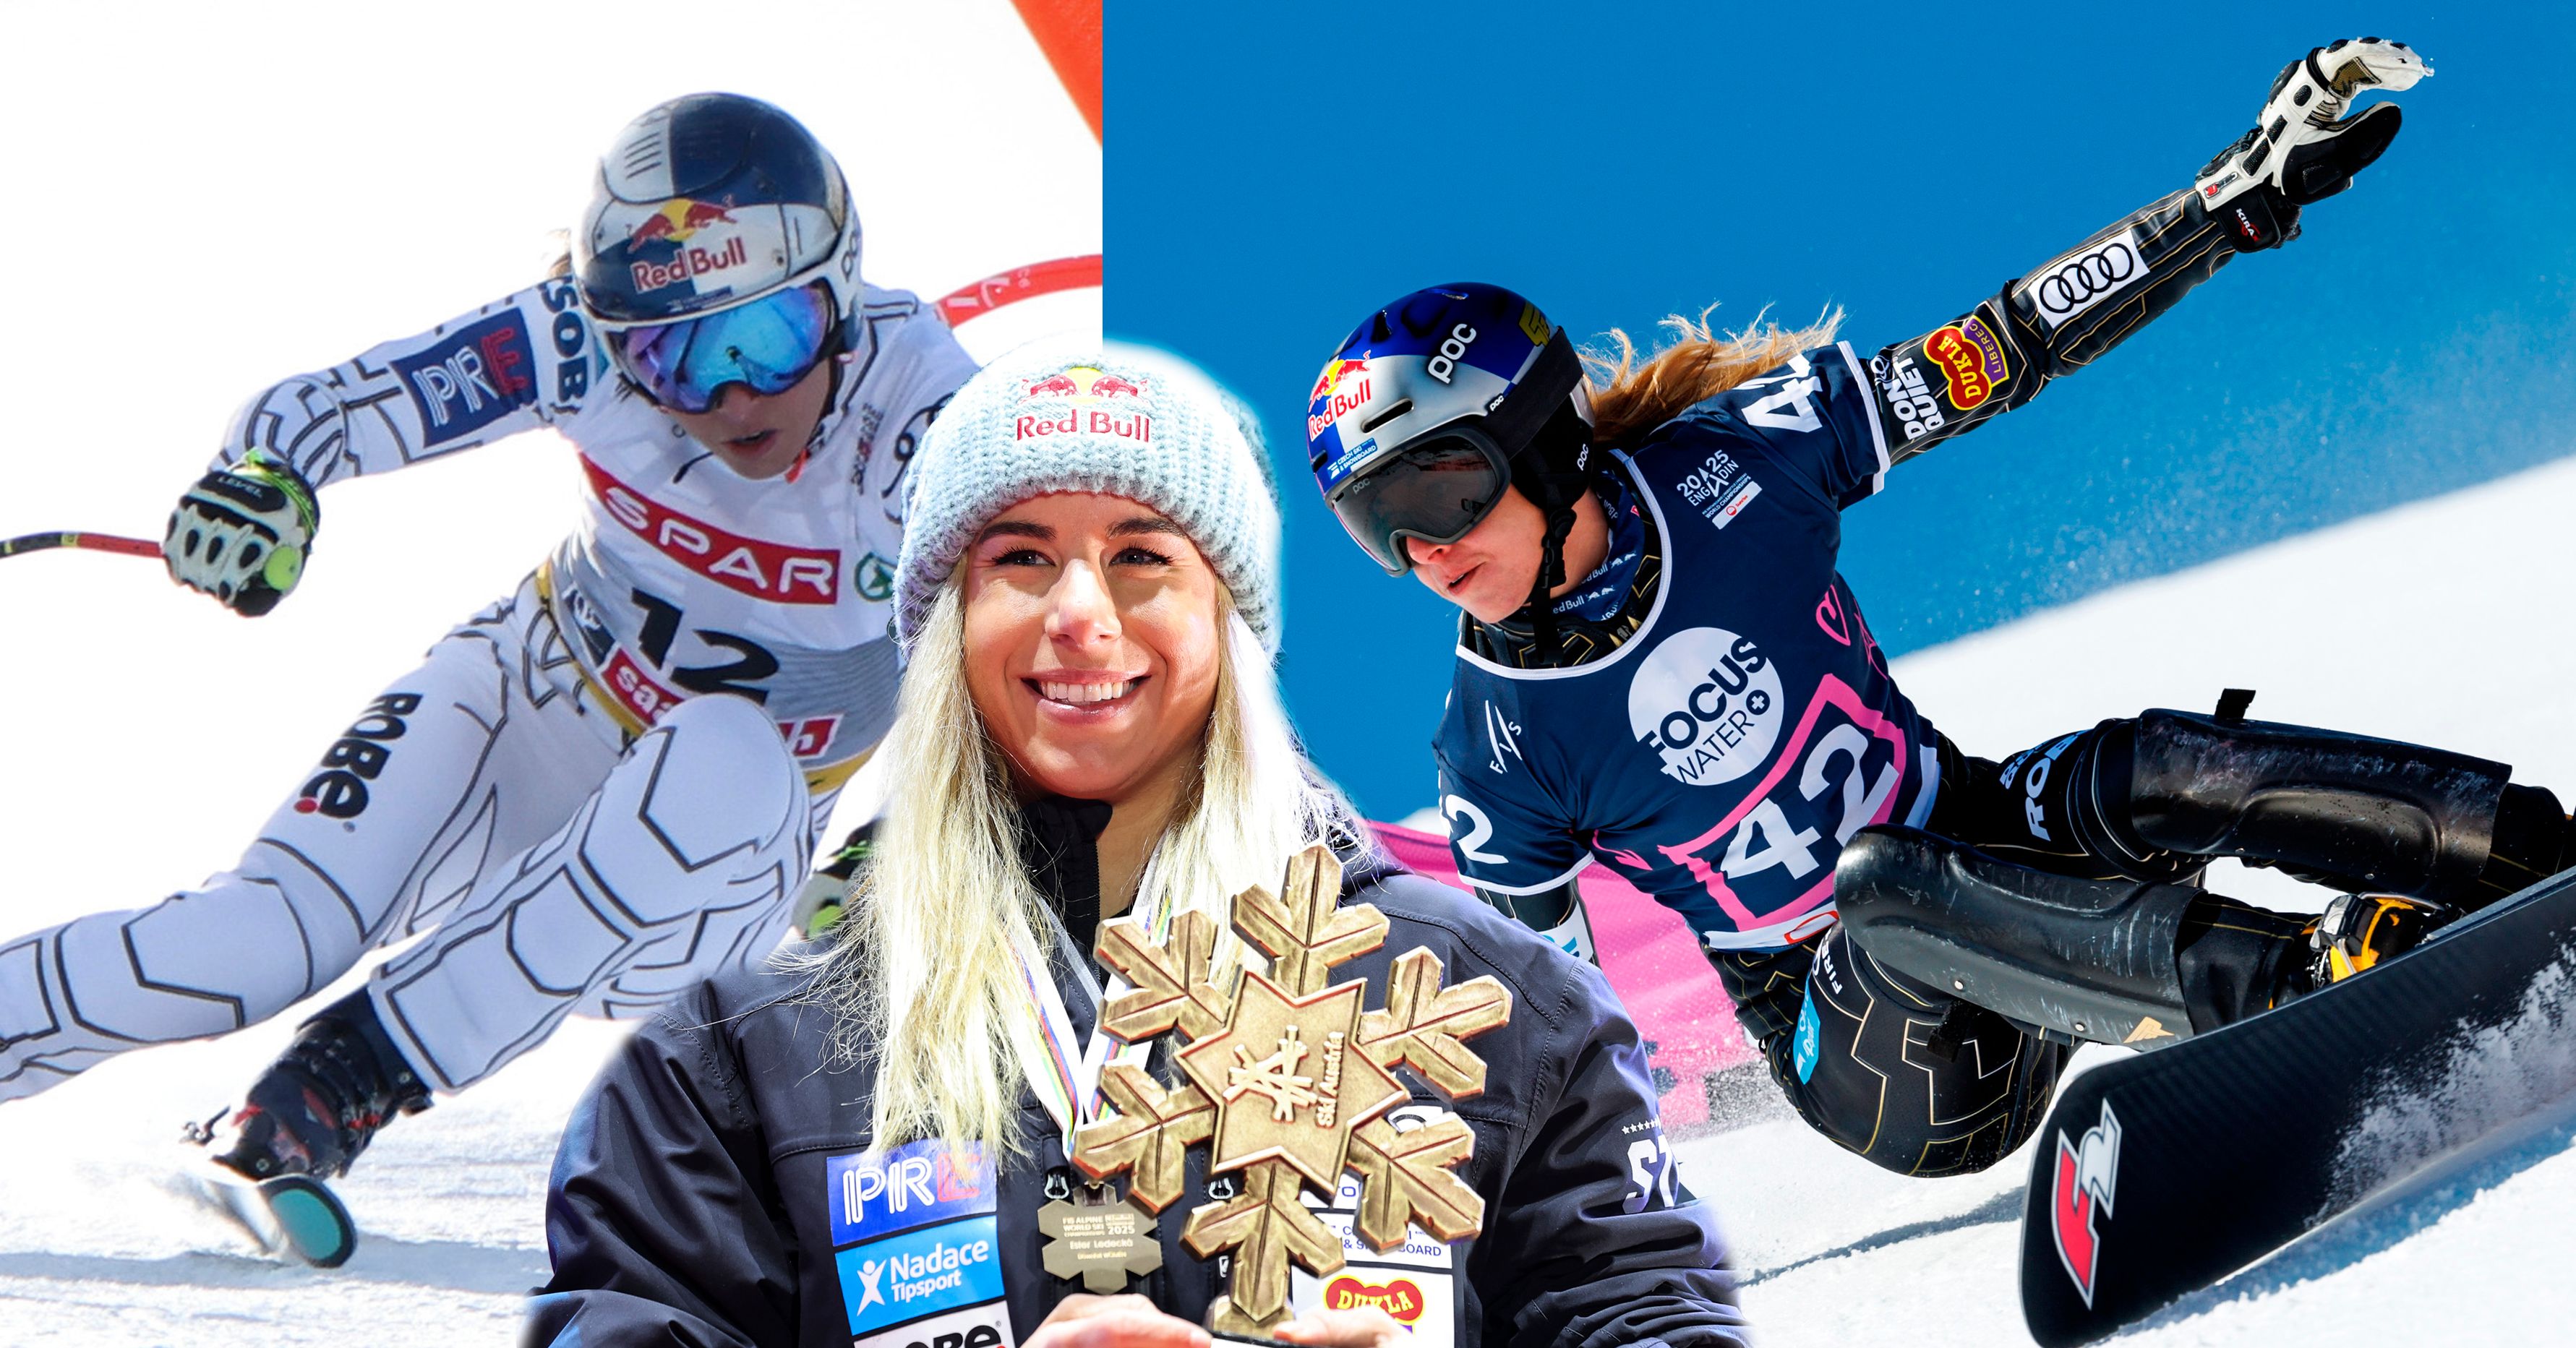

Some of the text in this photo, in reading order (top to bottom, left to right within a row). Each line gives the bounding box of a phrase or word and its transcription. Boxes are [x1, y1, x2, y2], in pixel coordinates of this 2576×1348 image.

[632, 236, 748, 292] Red Bull
[411, 327, 529, 427] PRE
[1937, 335, 1982, 399] DUKLA
[1969, 322, 2002, 374] LIBEREC
[1017, 408, 1150, 443] Red Bull
[1309, 379, 1372, 440] Red Bull
[606, 486, 834, 596] SPAR
[1565, 595, 1586, 610] Bull
[630, 587, 779, 706] 12
[1639, 637, 1767, 765] FOCUS
[1676, 710, 1755, 784] WATER
[1720, 723, 1900, 880] 42
[842, 1152, 981, 1226] PRE
[1108, 1225, 1136, 1236] 2025
[890, 1240, 990, 1284] Nadace
[890, 1269, 963, 1303] Tipsport
